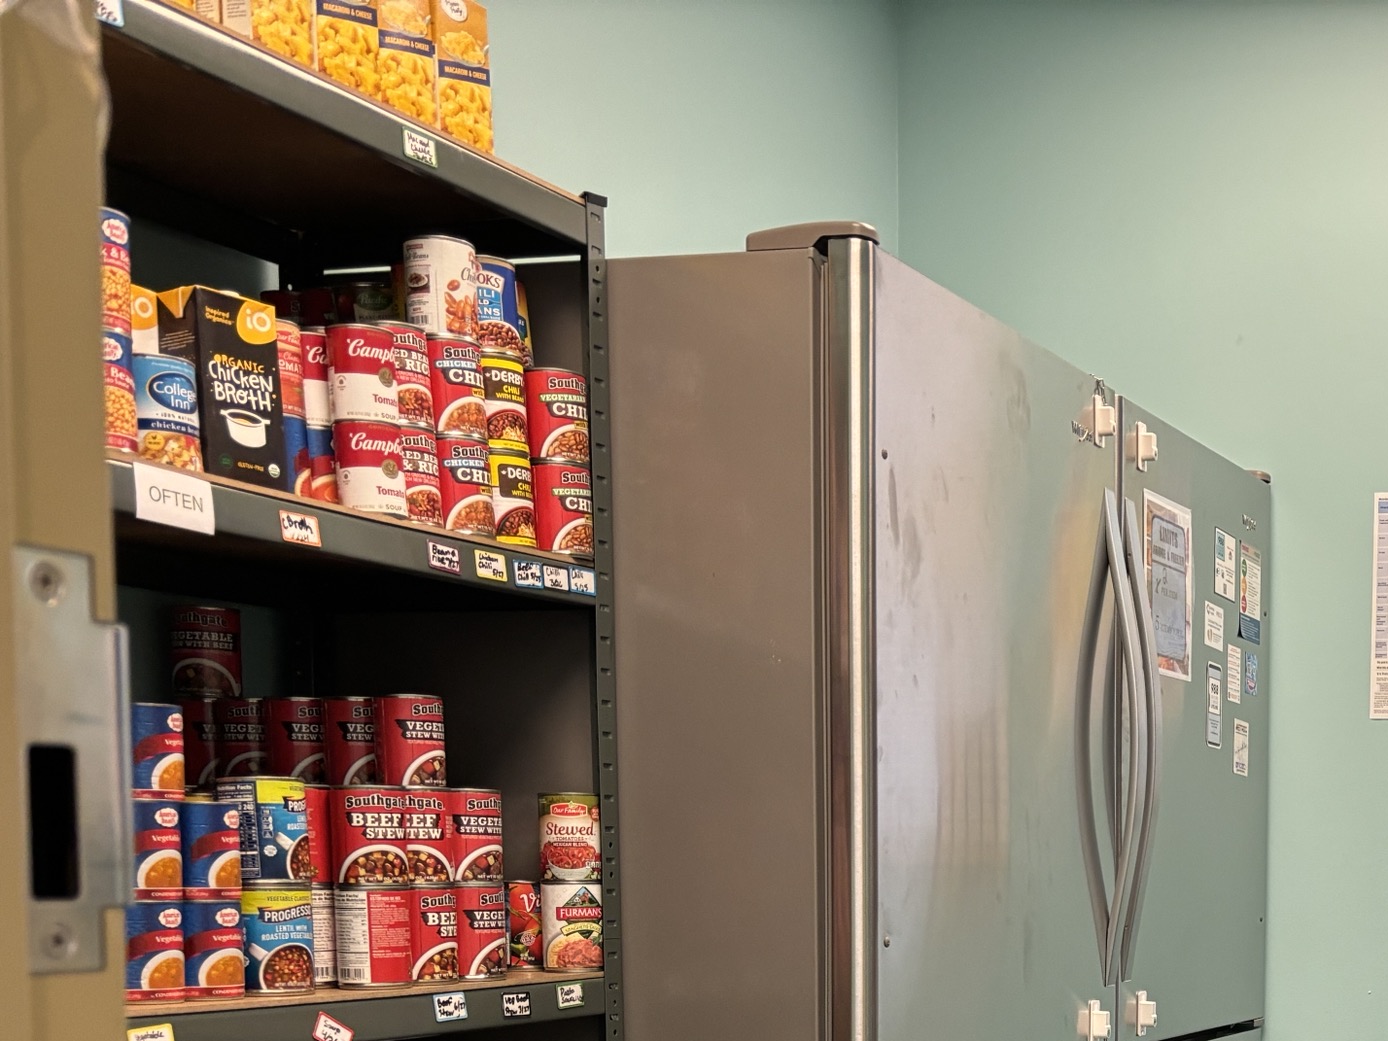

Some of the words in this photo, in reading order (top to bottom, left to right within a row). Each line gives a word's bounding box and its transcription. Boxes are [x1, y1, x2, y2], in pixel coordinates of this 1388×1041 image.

[355, 9, 373, 20] CHEESE
[415, 41, 430, 52] CHEESE
[472, 71, 487, 80] CHEESE
[213, 354, 265, 373] ORGANIC
[171, 396, 190, 411] Inn
[151, 421, 186, 431] chicken
[149, 485, 204, 513] OFTEN
[405, 731, 430, 740] STEW
[460, 826, 485, 834] STEW
[545, 821, 594, 836] Stewed
